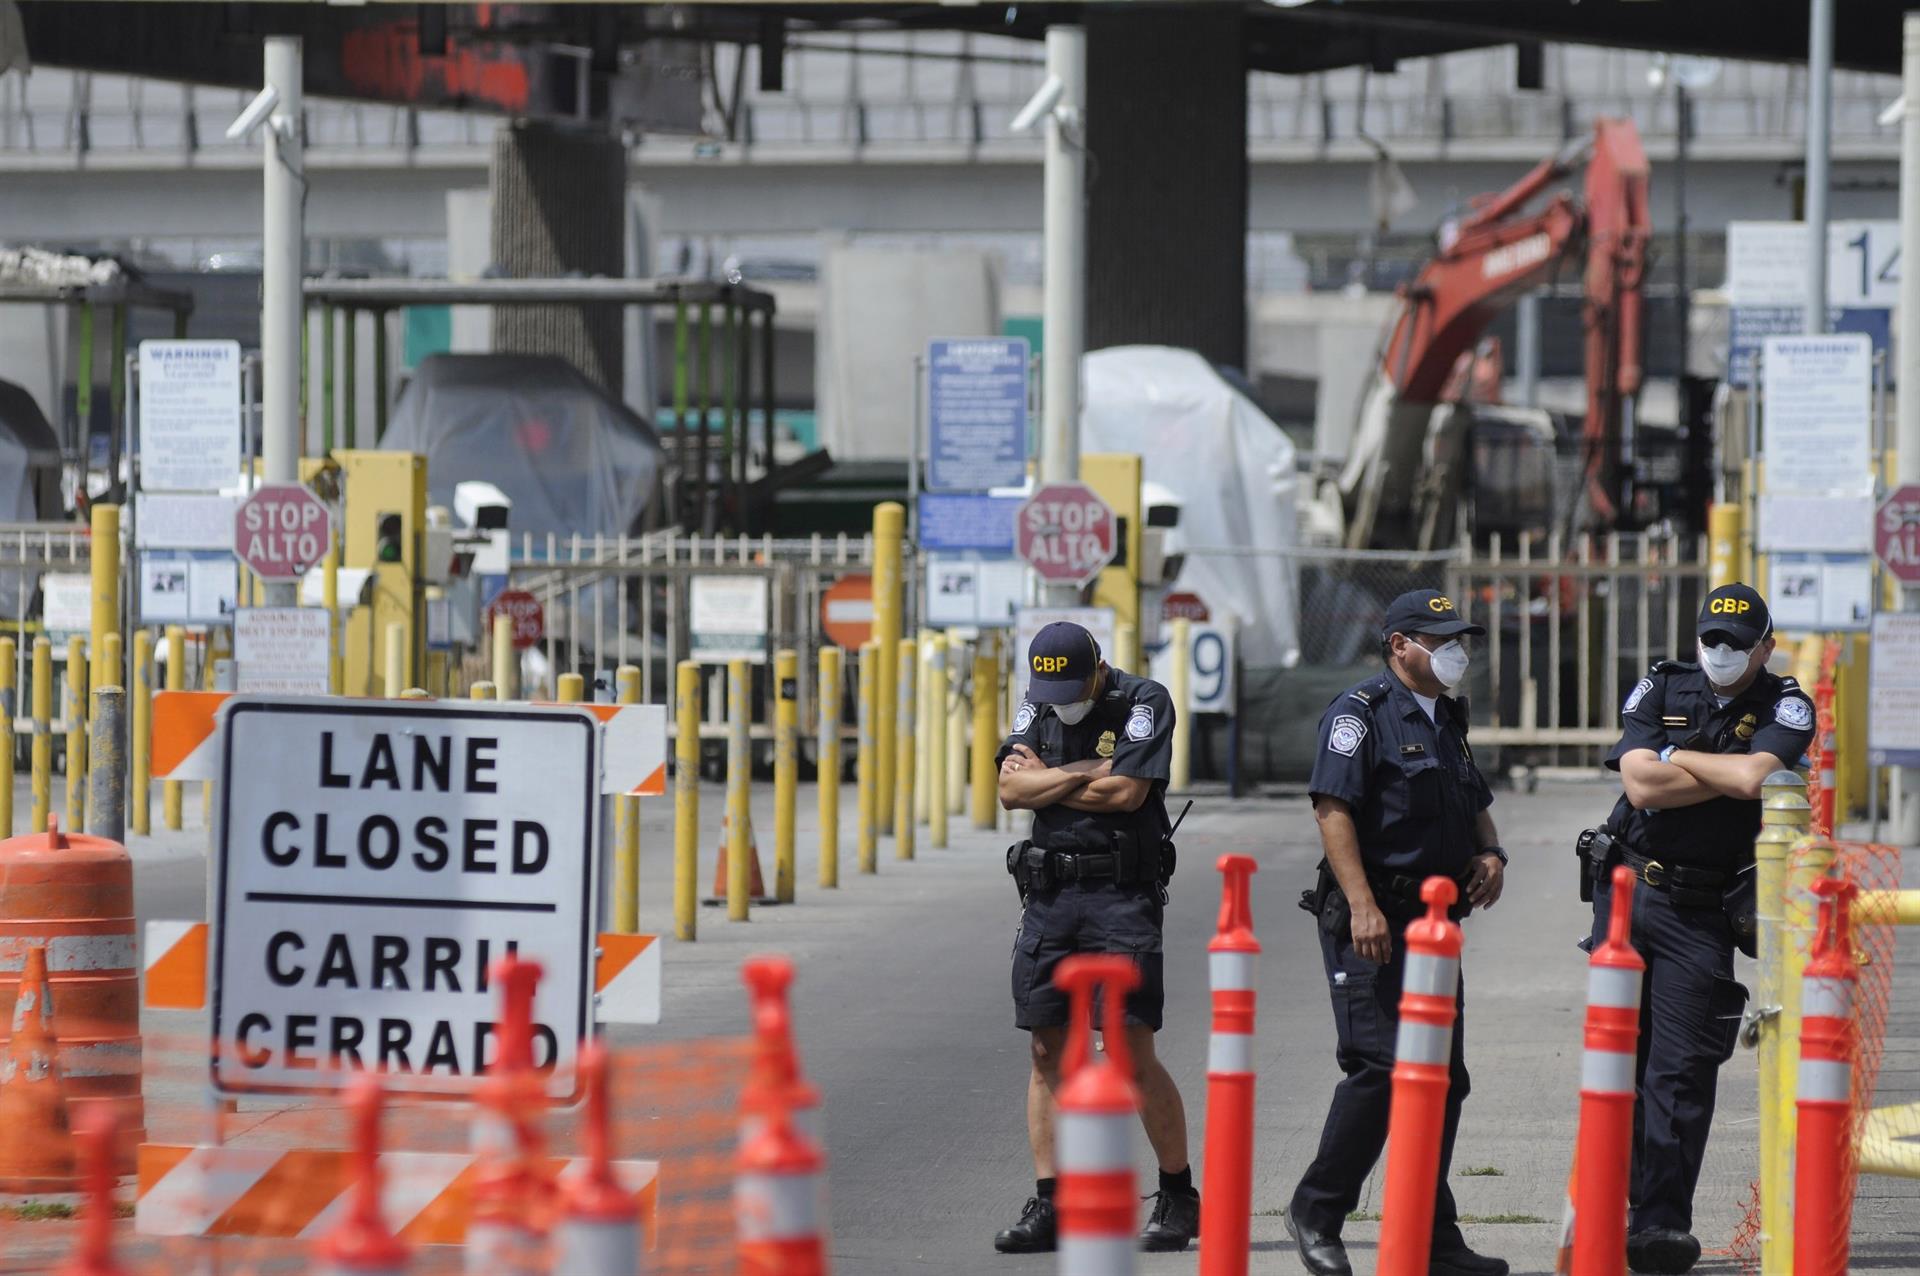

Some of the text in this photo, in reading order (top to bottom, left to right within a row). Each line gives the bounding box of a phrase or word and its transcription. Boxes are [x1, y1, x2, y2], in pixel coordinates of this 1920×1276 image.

[245, 501, 321, 532] STOP
[1027, 502, 1105, 533] STOP
[247, 533, 319, 563] ALTO
[1030, 532, 1101, 569] ALTO
[495, 600, 538, 617] STOP
[1428, 597, 1454, 612] CB
[1710, 598, 1750, 615] CBP
[1033, 655, 1068, 673] CBP
[1193, 632, 1225, 701] 9
[319, 731, 499, 793] LANE
[261, 811, 549, 875] CLOSED
[265, 930, 537, 997] CARRI
[236, 1012, 558, 1077] CERRADO
